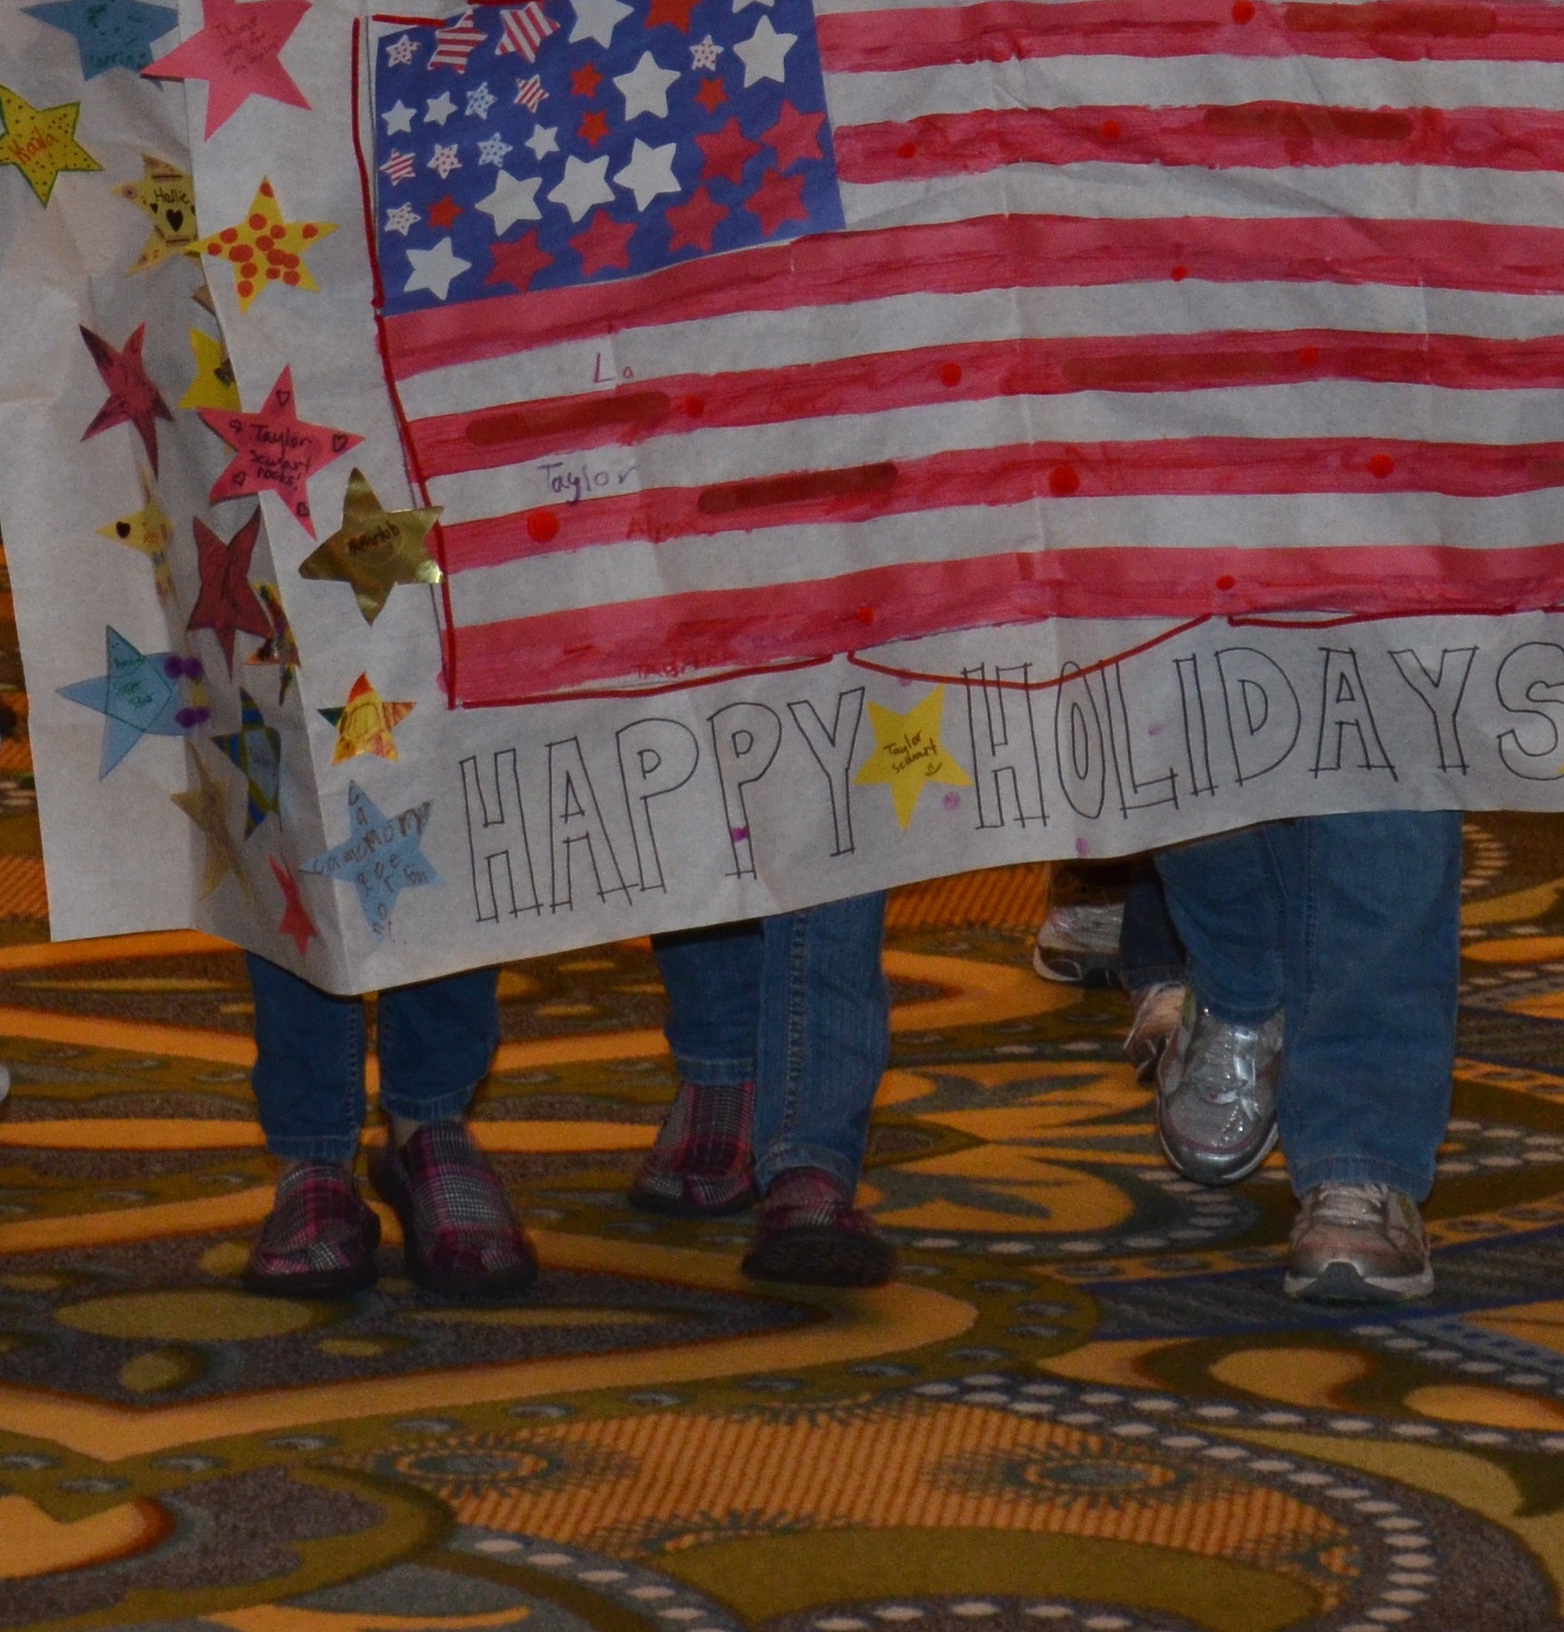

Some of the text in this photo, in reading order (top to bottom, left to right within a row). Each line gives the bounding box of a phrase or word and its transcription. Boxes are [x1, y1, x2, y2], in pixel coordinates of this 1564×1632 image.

[248, 422, 315, 452] Taylor
[537, 461, 638, 507] Taylor
[457, 687, 867, 925] HAPPY
